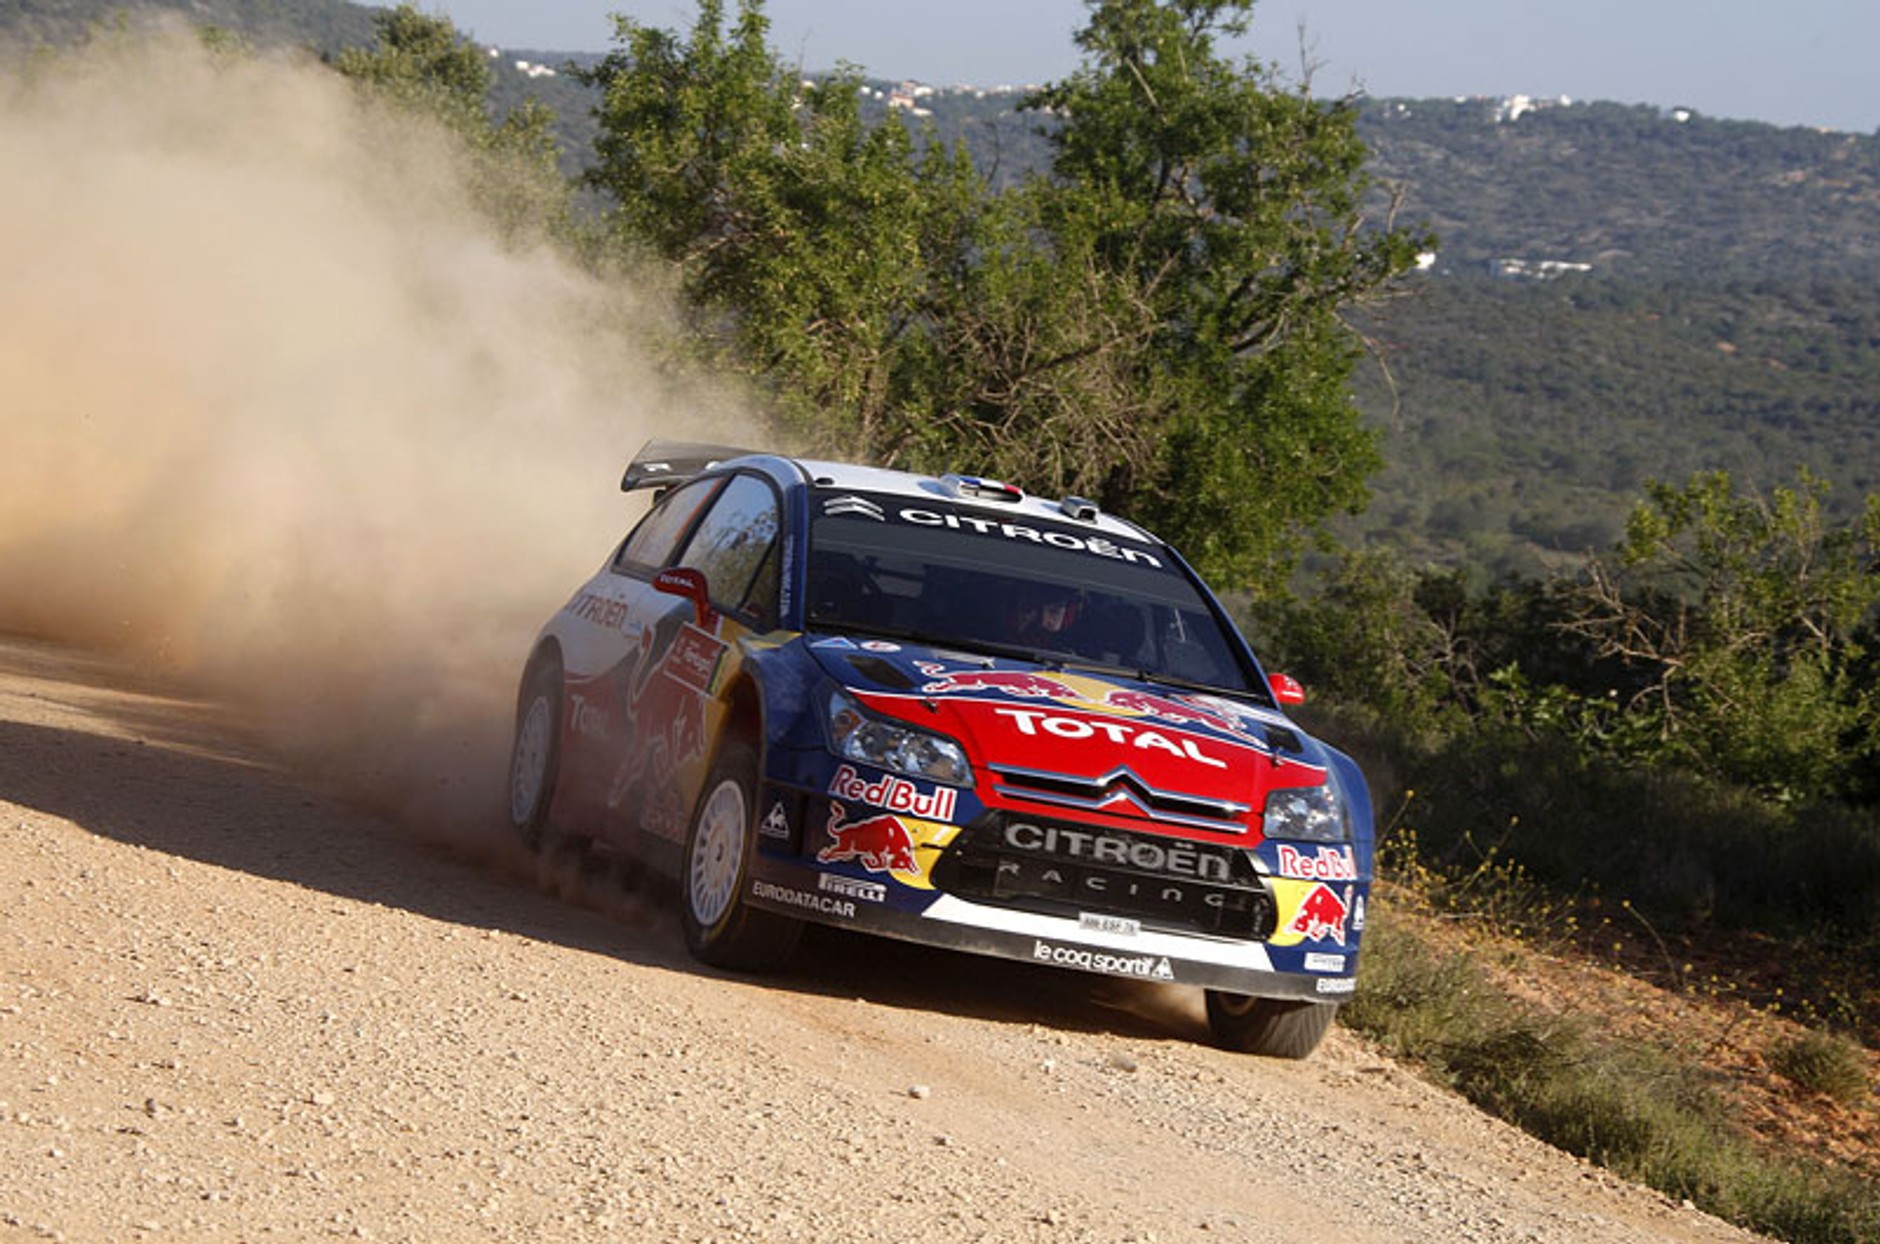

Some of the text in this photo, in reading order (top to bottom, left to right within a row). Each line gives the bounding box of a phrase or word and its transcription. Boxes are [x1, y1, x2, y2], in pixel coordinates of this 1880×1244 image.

[995, 708, 1228, 768] TOTAL
[752, 881, 856, 918] EURODATACAR
[818, 872, 887, 902] PIRELLI
[998, 860, 1225, 907] RACING
